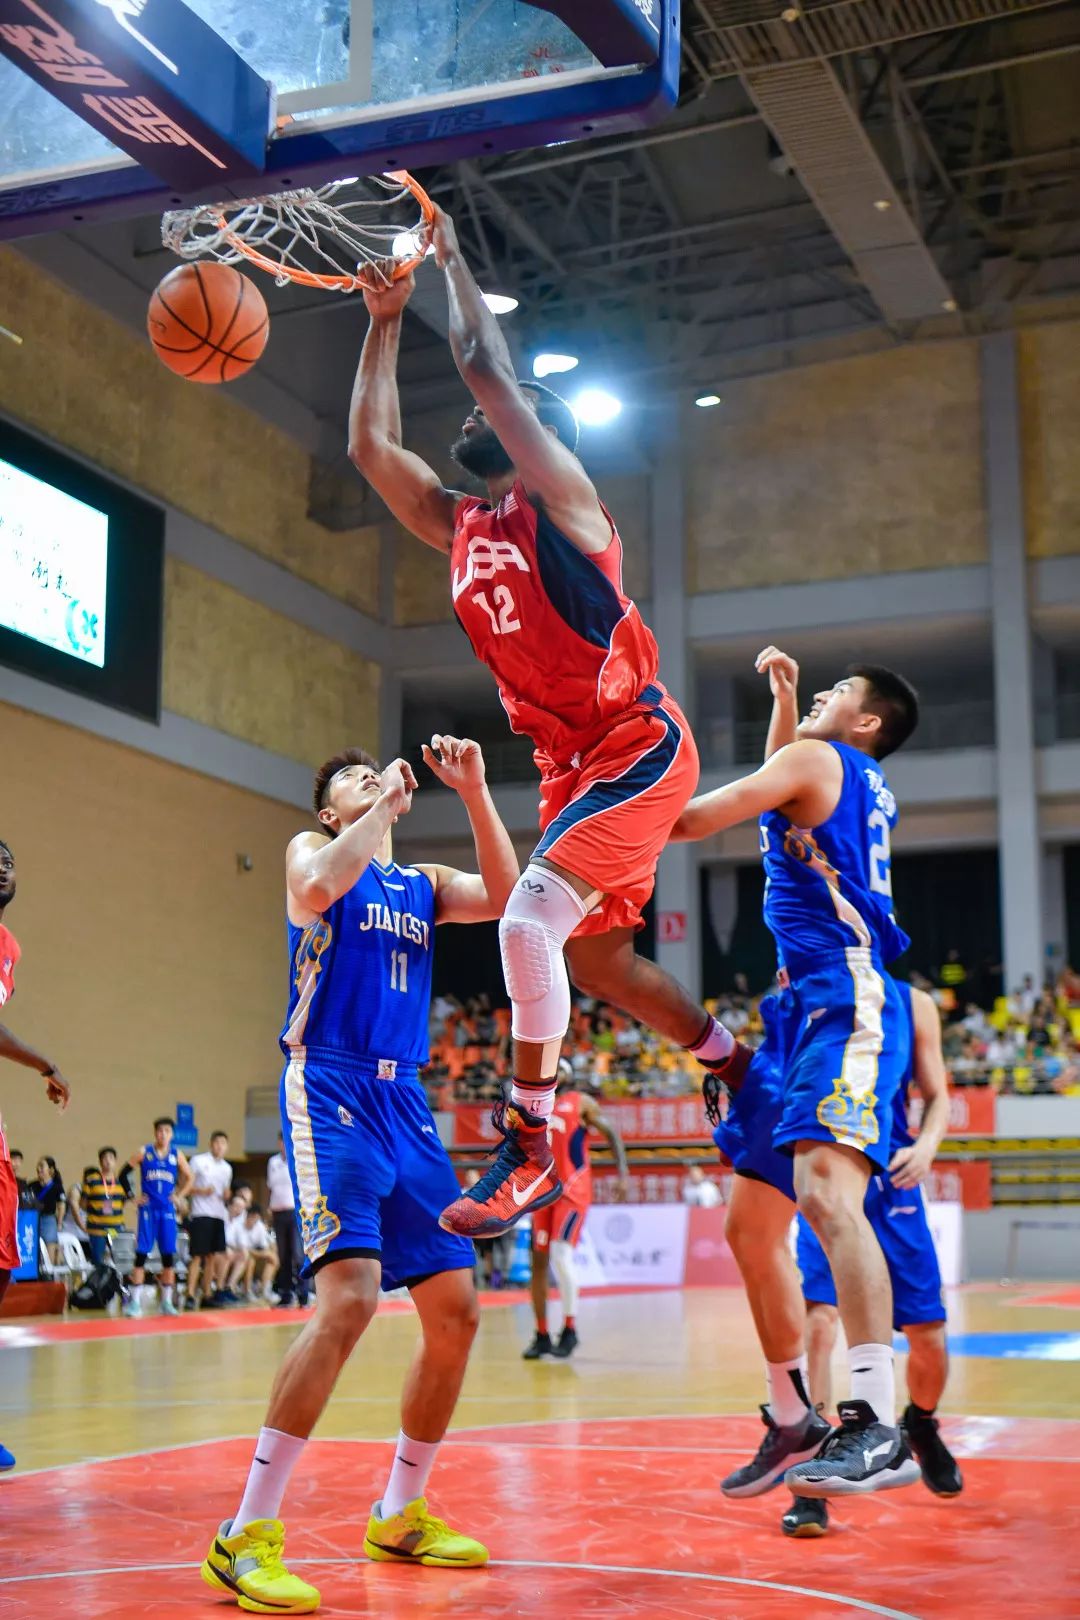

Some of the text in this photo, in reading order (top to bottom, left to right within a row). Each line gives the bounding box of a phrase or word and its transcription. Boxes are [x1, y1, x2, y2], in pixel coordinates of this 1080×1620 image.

[452, 535, 530, 602] USA
[472, 584, 521, 635] 12
[390, 949, 408, 993] 11
